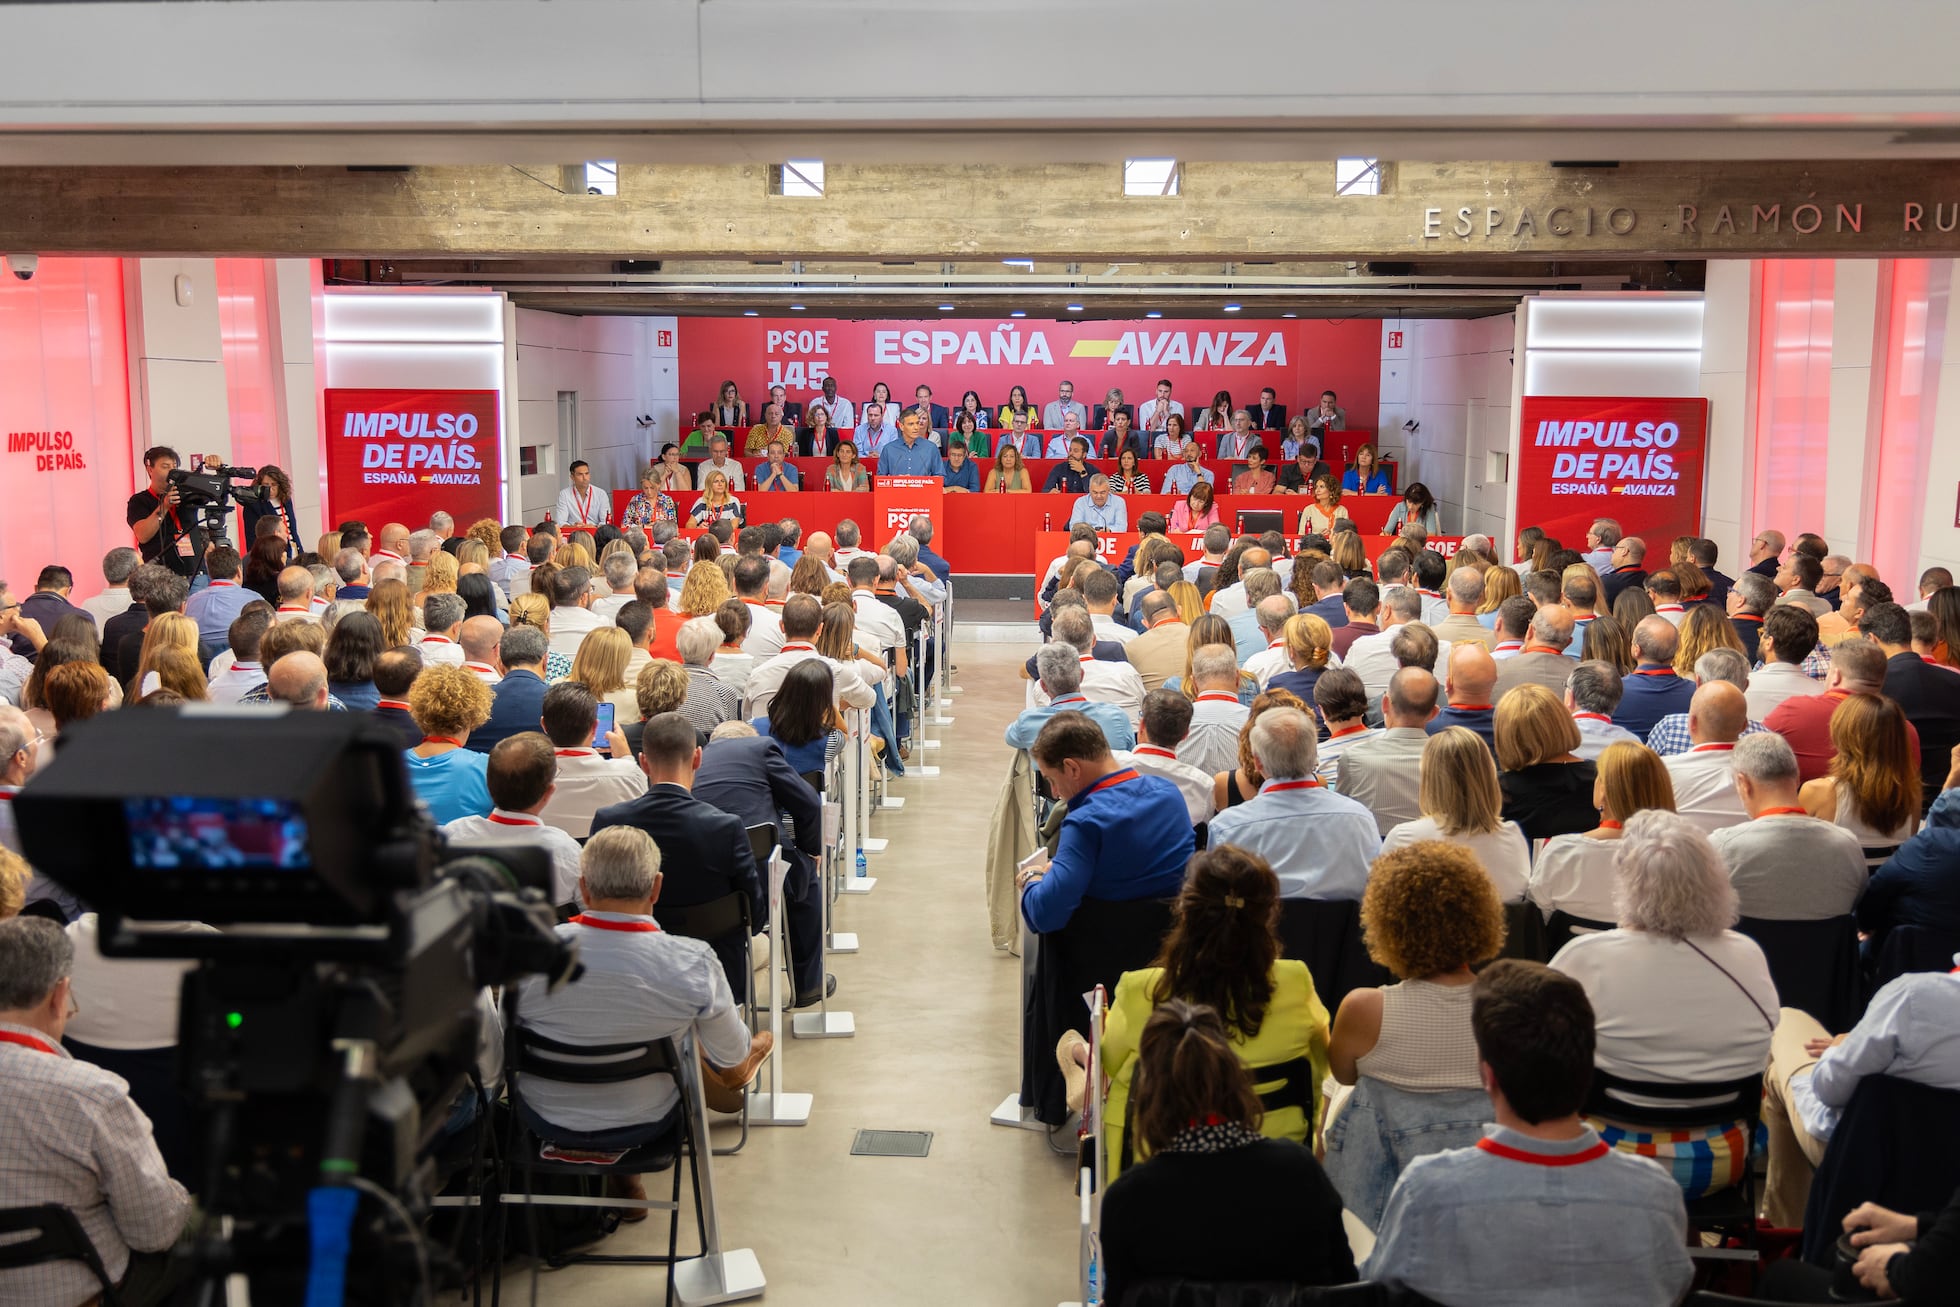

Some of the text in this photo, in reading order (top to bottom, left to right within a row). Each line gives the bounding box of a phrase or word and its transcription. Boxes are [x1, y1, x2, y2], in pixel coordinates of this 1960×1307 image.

[1423, 191, 1958, 239] ESPACIO RAMÓN RU
[767, 329, 830, 354] PSOE
[874, 323, 1288, 367] ESPAÑA AVANZA
[767, 361, 830, 390] 145
[343, 412, 479, 439] IMPULSO
[1534, 421, 1679, 448] IMPULSO
[8, 431, 73, 452] IMPULSO
[362, 439, 483, 469] DE PAÍS.
[36, 449, 86, 472] DE PAÍS.
[1552, 449, 1680, 480] DE PAÍS.
[364, 471, 481, 485] ESPAÑA AVANZA
[1551, 481, 1676, 496] ESPAÑA AVANZA
[1095, 537, 1117, 555] OE
[1423, 541, 1457, 557] SOE
